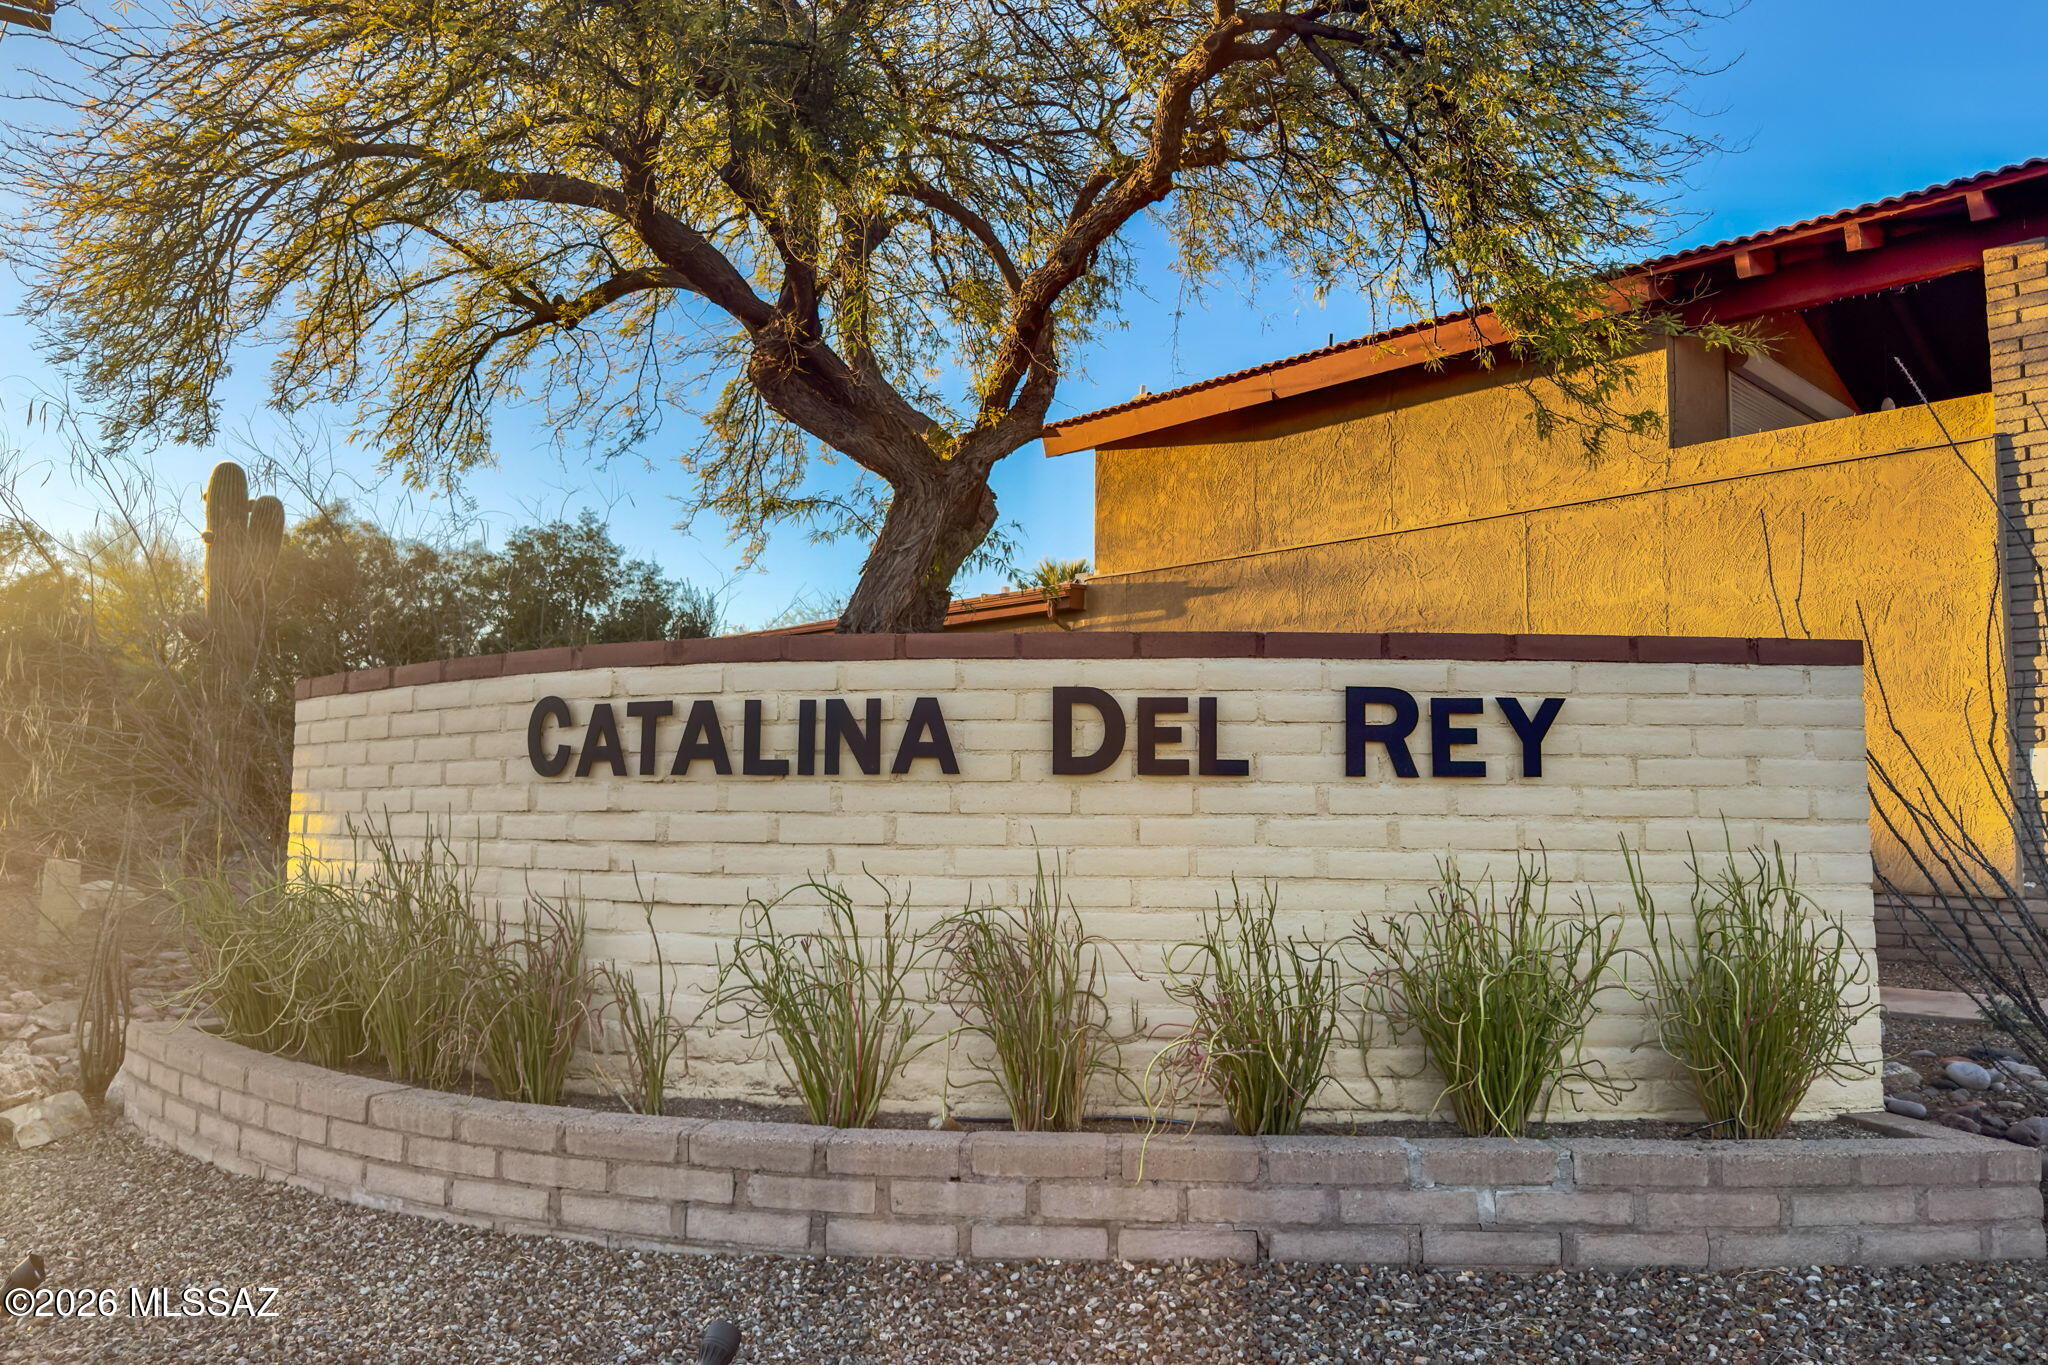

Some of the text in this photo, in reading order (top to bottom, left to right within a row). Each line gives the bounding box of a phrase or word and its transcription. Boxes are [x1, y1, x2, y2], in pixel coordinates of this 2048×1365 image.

[528, 686, 1567, 780] CATALINA DEL REY
